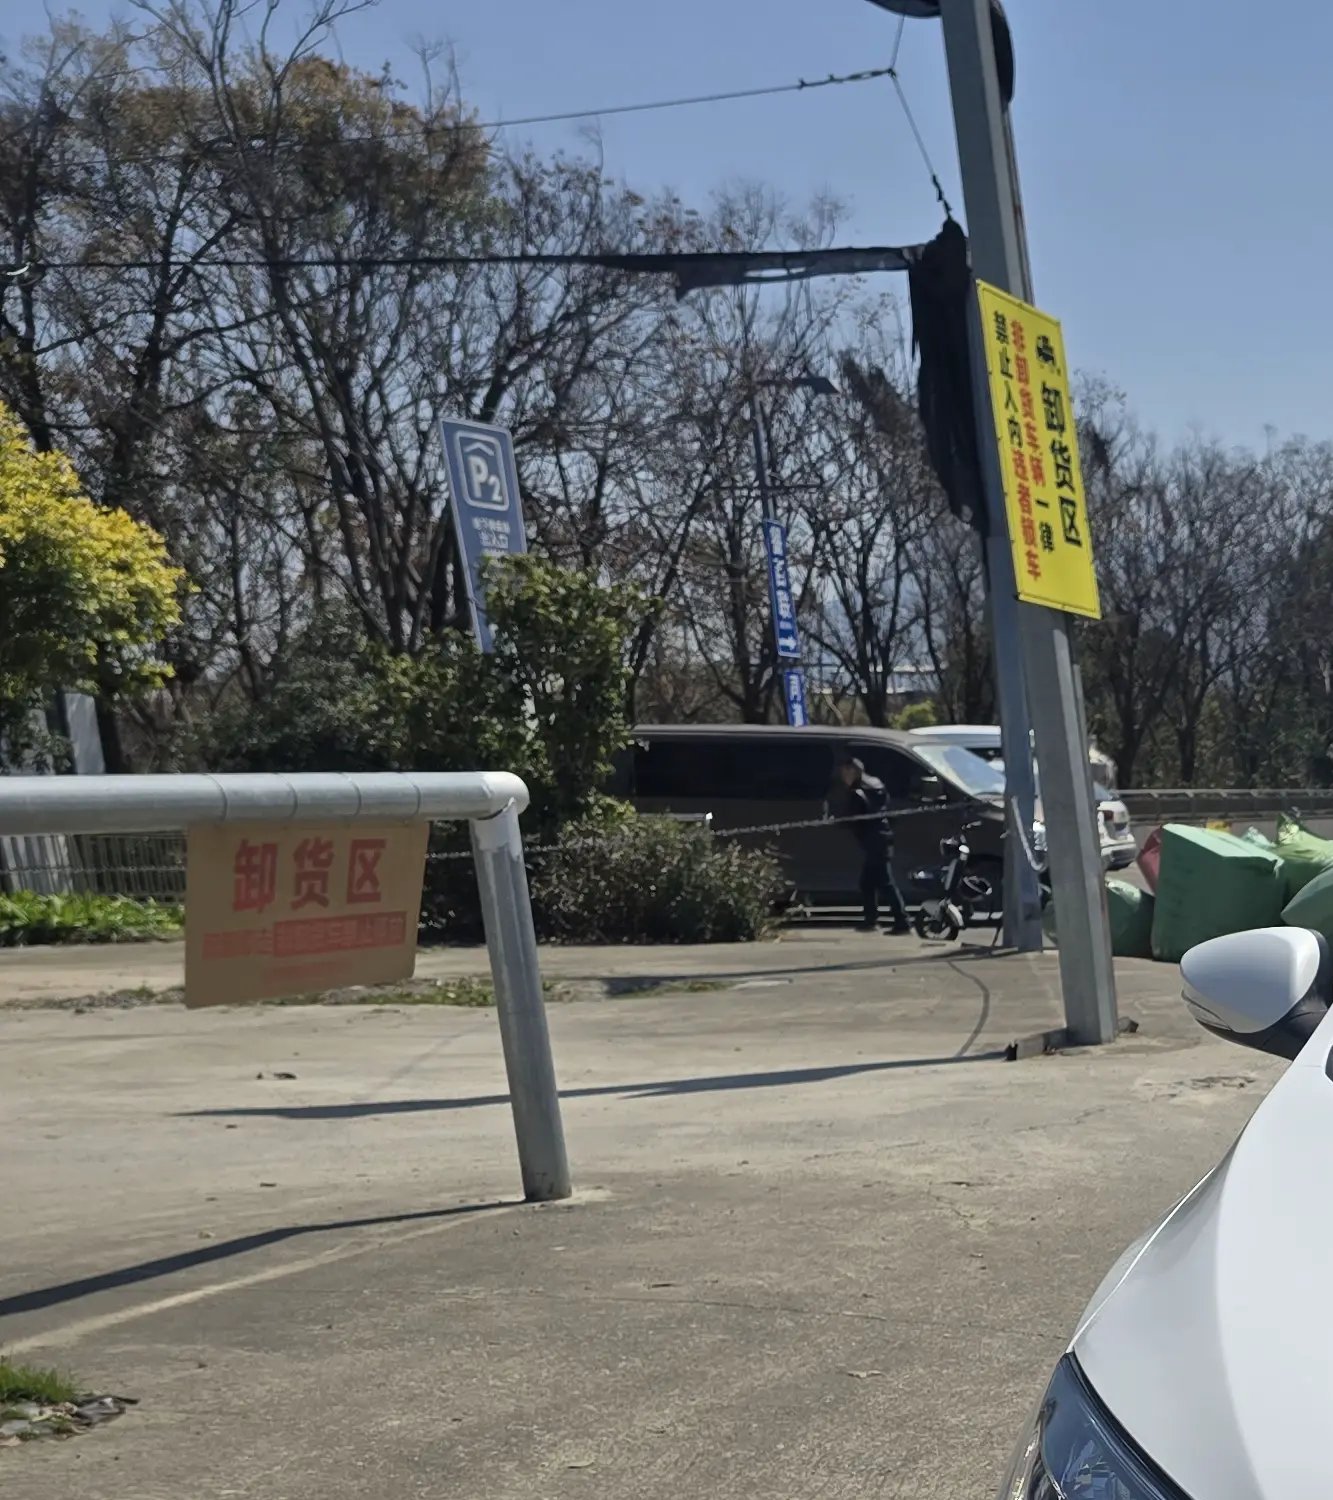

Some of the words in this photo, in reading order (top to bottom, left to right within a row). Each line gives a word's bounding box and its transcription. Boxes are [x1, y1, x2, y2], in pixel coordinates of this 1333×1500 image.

[1040, 381, 1083, 548] 卸货区
[232, 835, 388, 914] 卸货区
